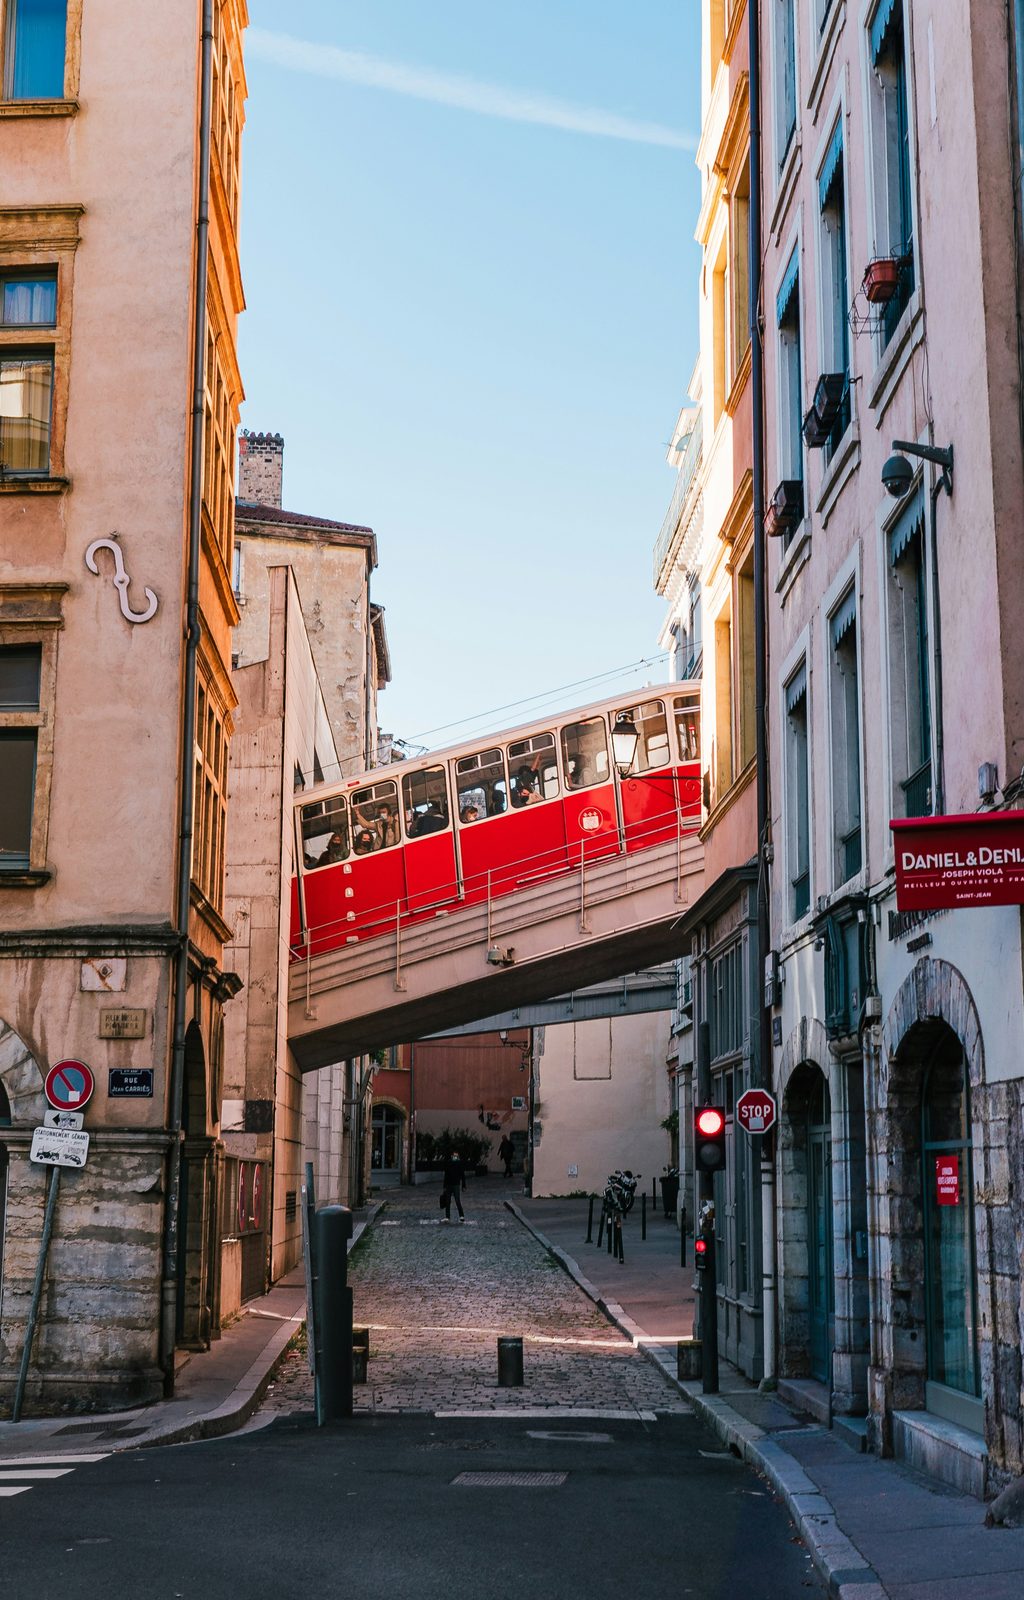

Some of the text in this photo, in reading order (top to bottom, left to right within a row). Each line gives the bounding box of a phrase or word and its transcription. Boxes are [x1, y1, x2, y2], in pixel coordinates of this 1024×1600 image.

[942, 868, 1003, 878] JOSEPH VIOLA
[904, 881, 946, 889] MEILLEUR
[741, 1104, 771, 1118] STOP
